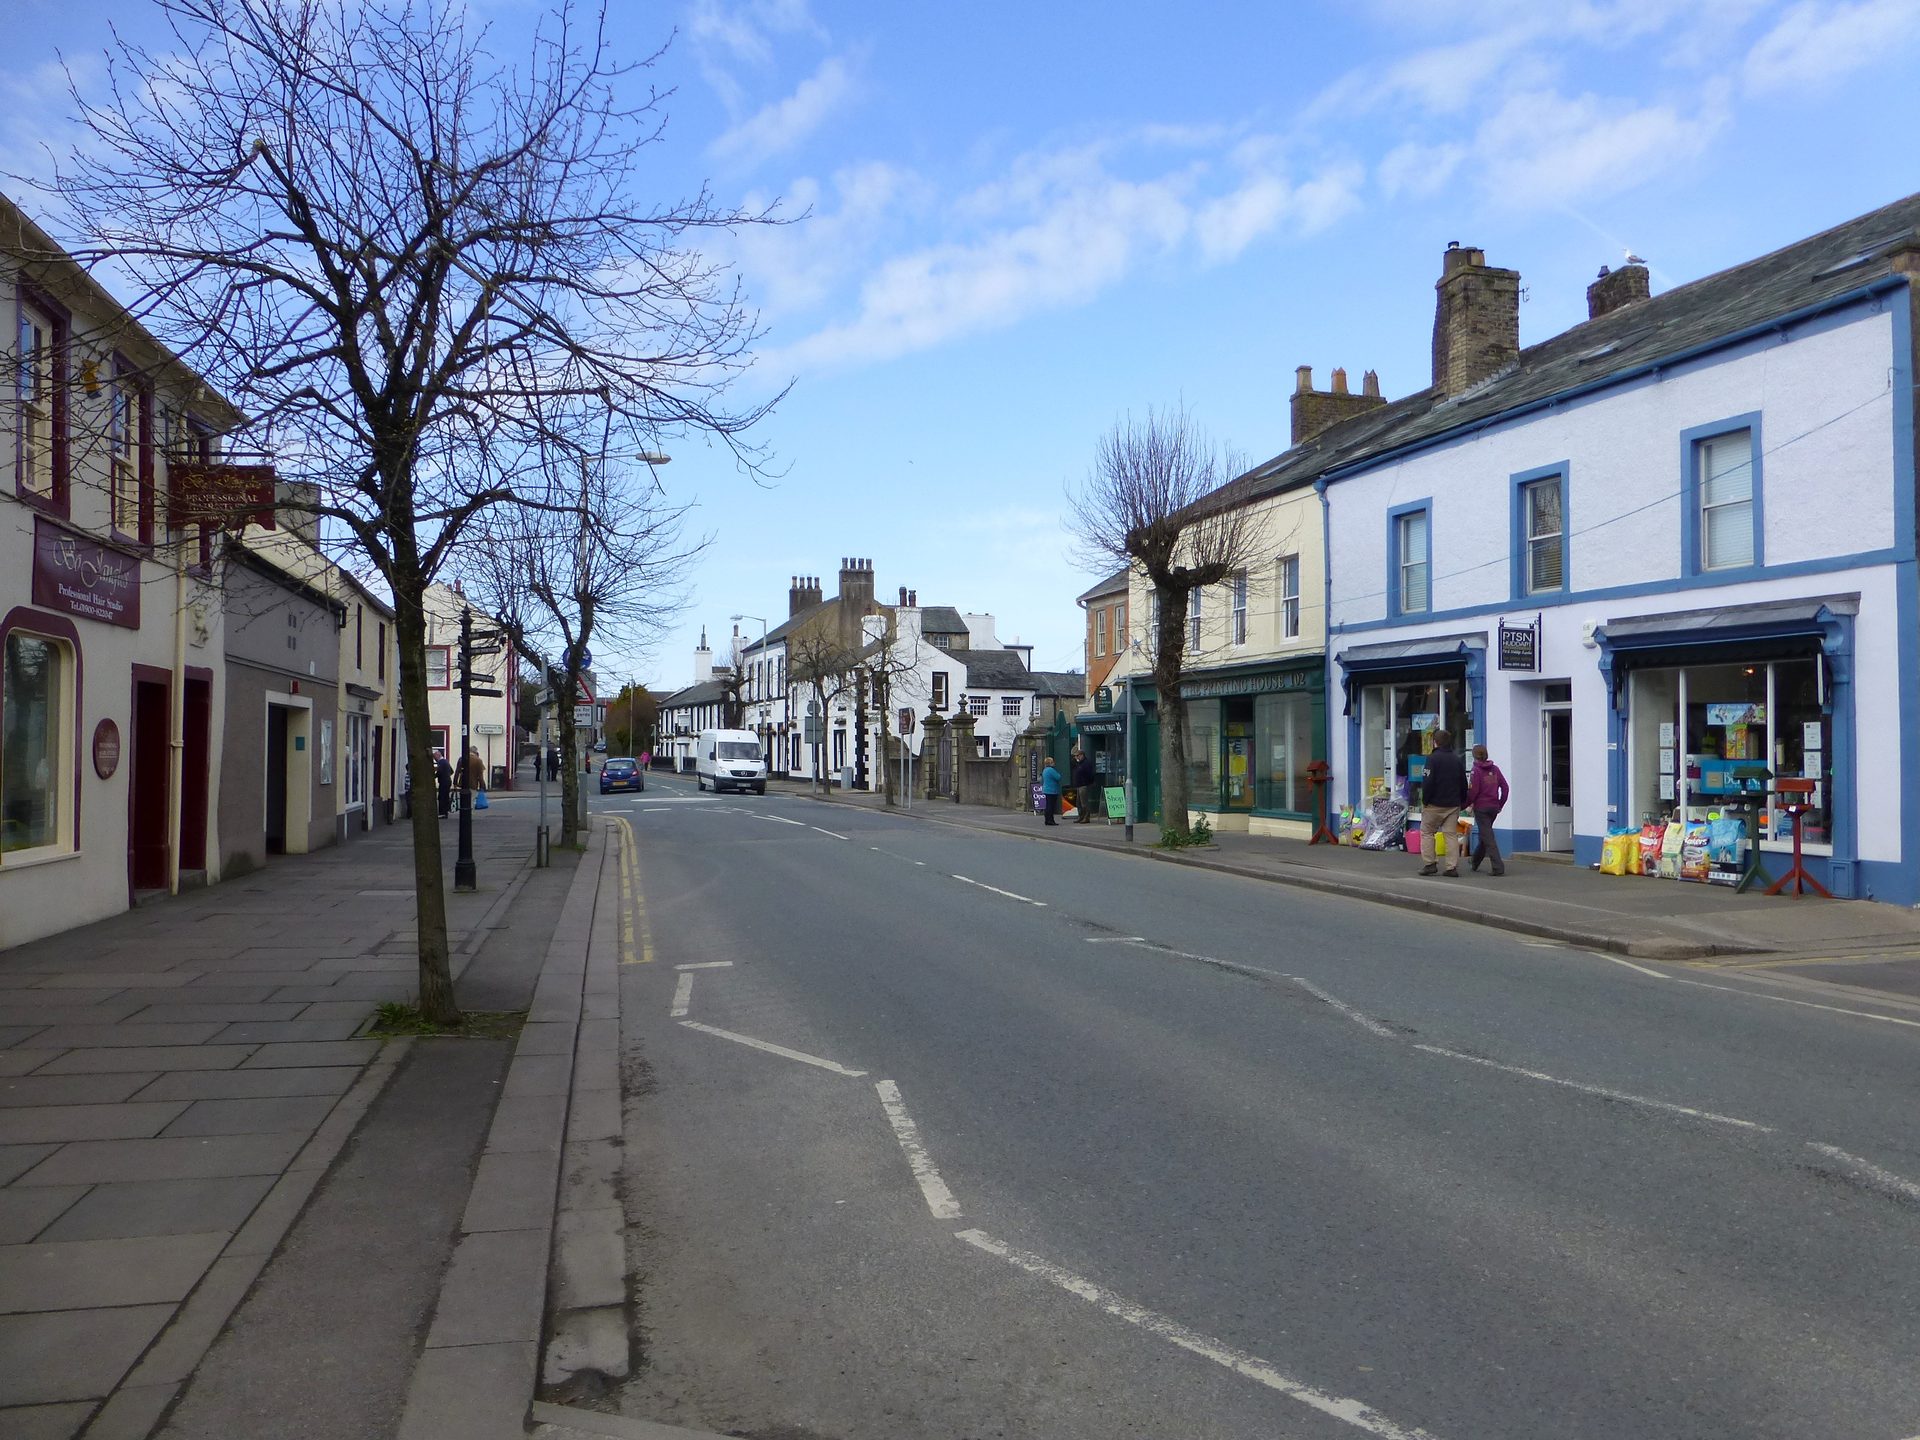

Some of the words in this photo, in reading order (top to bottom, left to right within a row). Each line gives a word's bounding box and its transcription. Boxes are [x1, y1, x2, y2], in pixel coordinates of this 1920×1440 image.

[58, 583, 92, 604] Professional
[93, 592, 106, 607] Hair
[107, 598, 124, 612] Studio
[1503, 631, 1532, 642] PTSN
[1184, 684, 1200, 698] THE
[1201, 679, 1248, 696] PRINTING
[1249, 675, 1285, 691] HOUSE
[1290, 673, 1306, 688] 102
[1033, 793, 1046, 801] Ope
[1107, 795, 1124, 805] Shop
